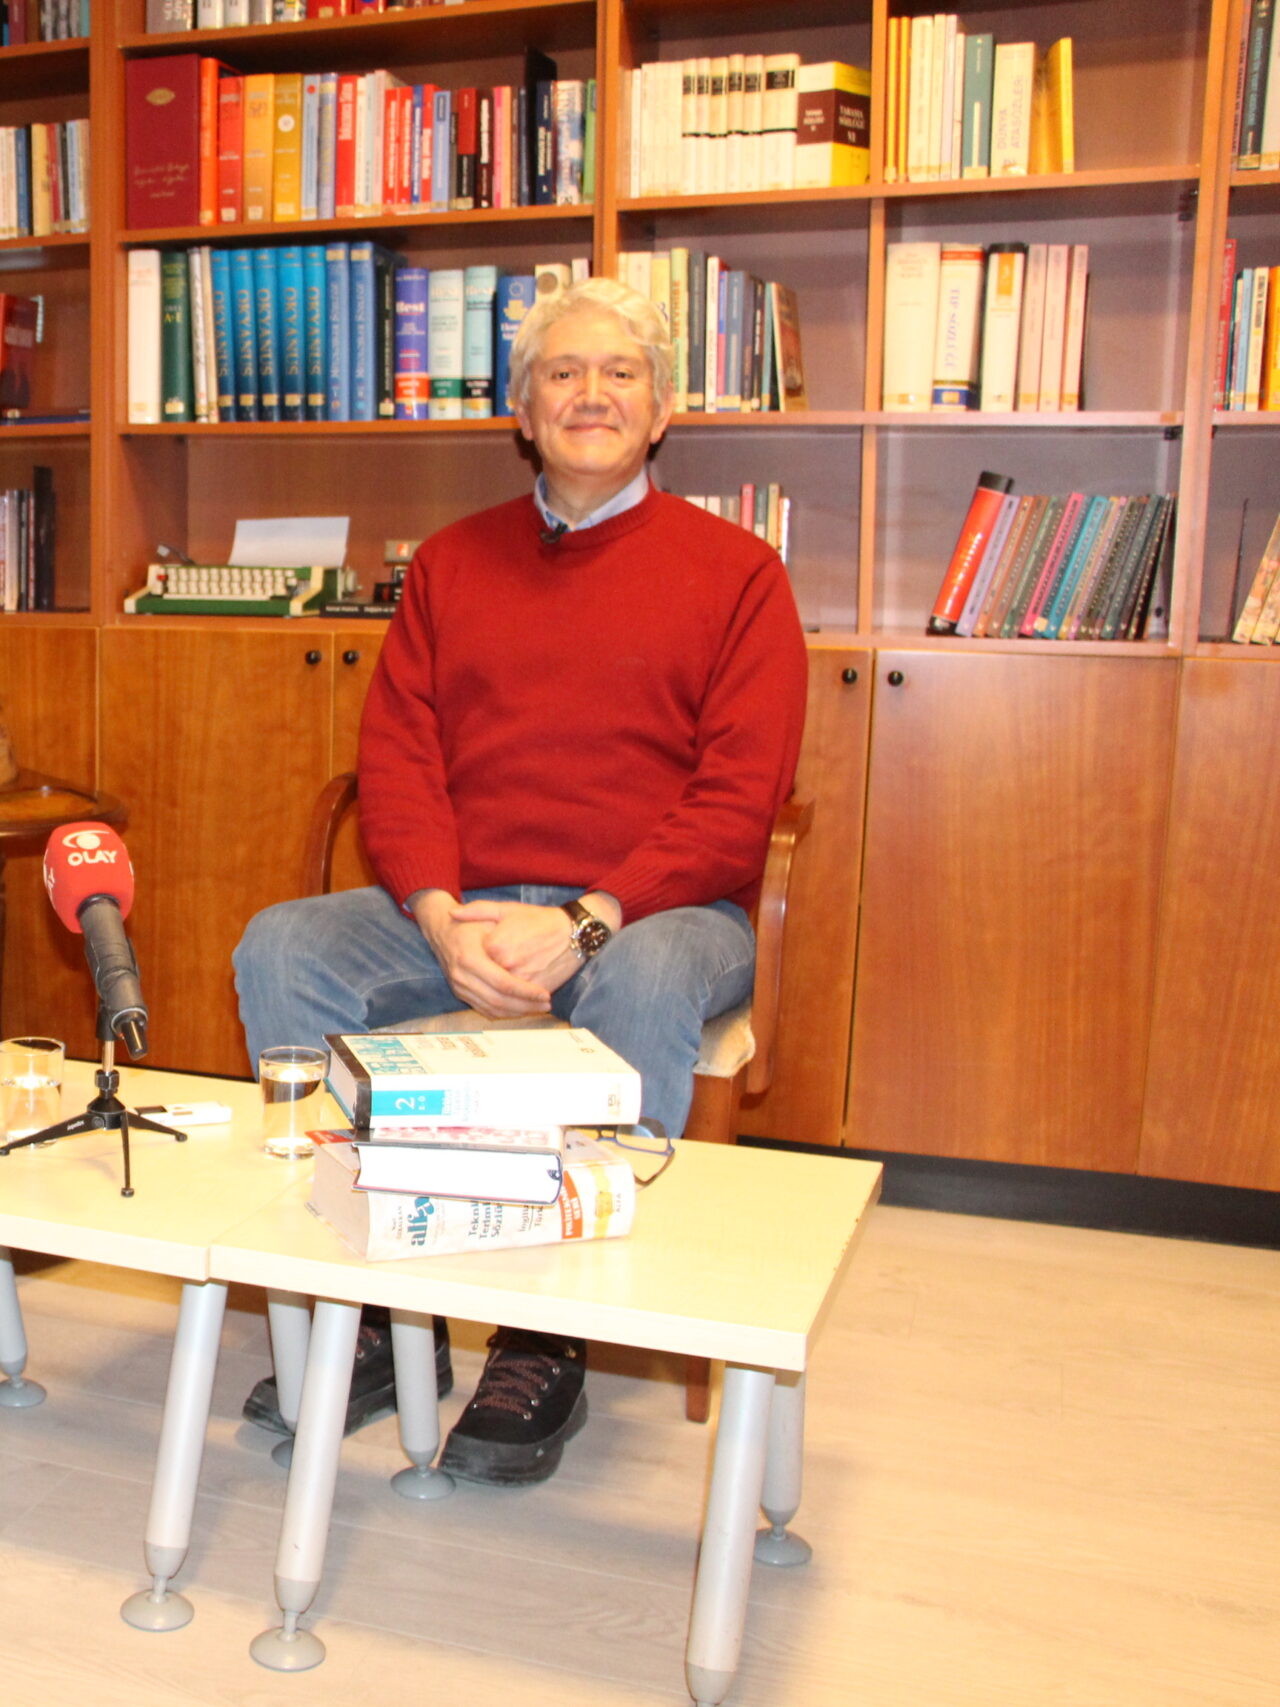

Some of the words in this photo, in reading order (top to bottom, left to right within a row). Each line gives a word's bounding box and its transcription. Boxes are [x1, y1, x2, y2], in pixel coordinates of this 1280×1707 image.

[237, 289, 252, 377] OKYANUS
[258, 288, 273, 376] OKYANUS
[283, 287, 299, 375] OKYANUS
[306, 286, 322, 375] OKYANUS
[67, 850, 117, 867] OLAY
[394, 1096, 416, 1111] 2
[406, 1196, 435, 1247] alfa
[468, 1201, 480, 1237] Tekni
[491, 1203, 503, 1239] Sözlü
